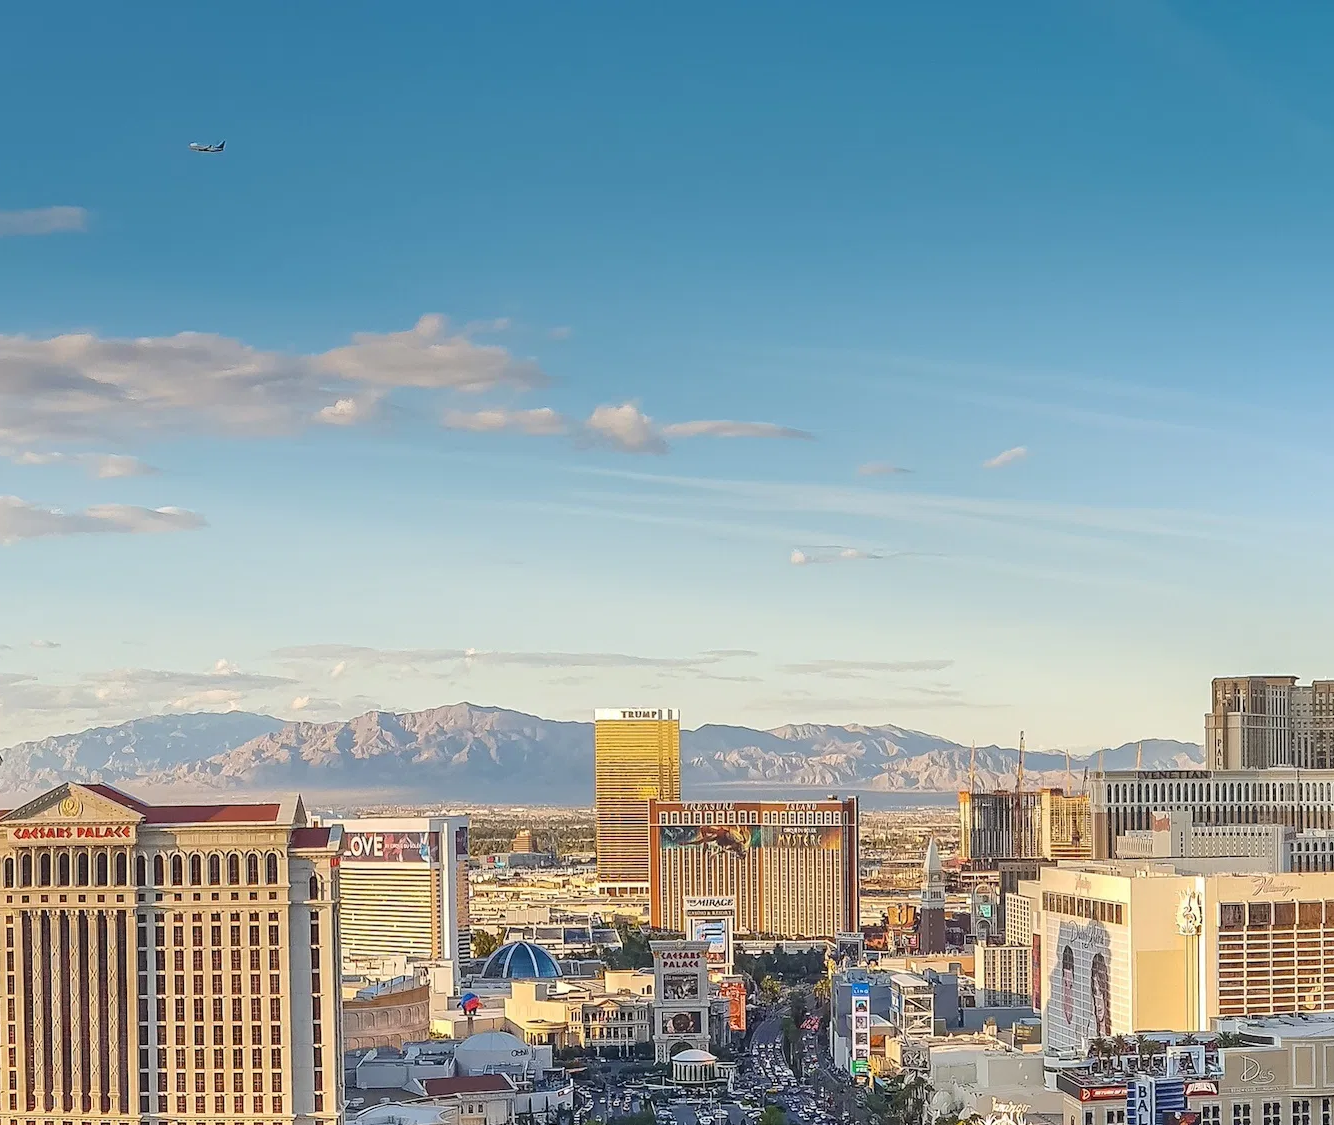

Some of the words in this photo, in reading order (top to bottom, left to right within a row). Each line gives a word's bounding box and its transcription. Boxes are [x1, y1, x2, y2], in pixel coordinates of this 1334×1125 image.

[1143, 771, 1208, 779] VENETIAN
[785, 803, 817, 811] ISLAND
[13, 827, 72, 840] CAESARS
[77, 826, 130, 838] PALACE
[690, 899, 733, 907] MIRAGE
